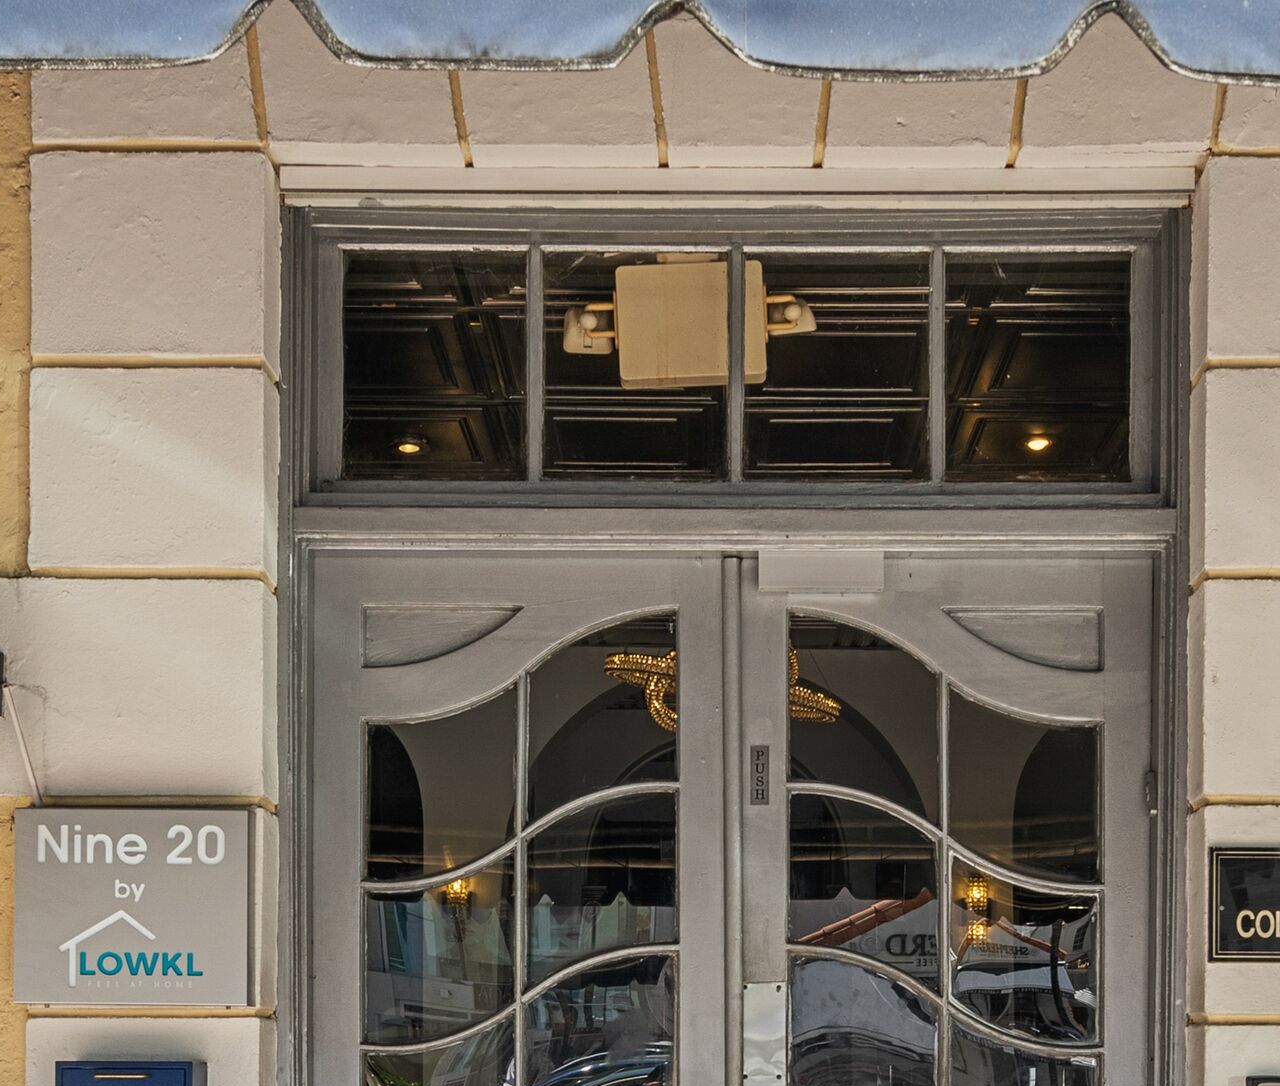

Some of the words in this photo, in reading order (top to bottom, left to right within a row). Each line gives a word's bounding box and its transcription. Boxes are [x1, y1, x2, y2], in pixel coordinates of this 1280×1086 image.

[37, 824, 148, 865] Nine
[166, 824, 226, 865] 20
[114, 879, 145, 902] by
[79, 951, 204, 977] LOWKL
[129, 980, 143, 989] AT
[153, 980, 193, 989] HOME
